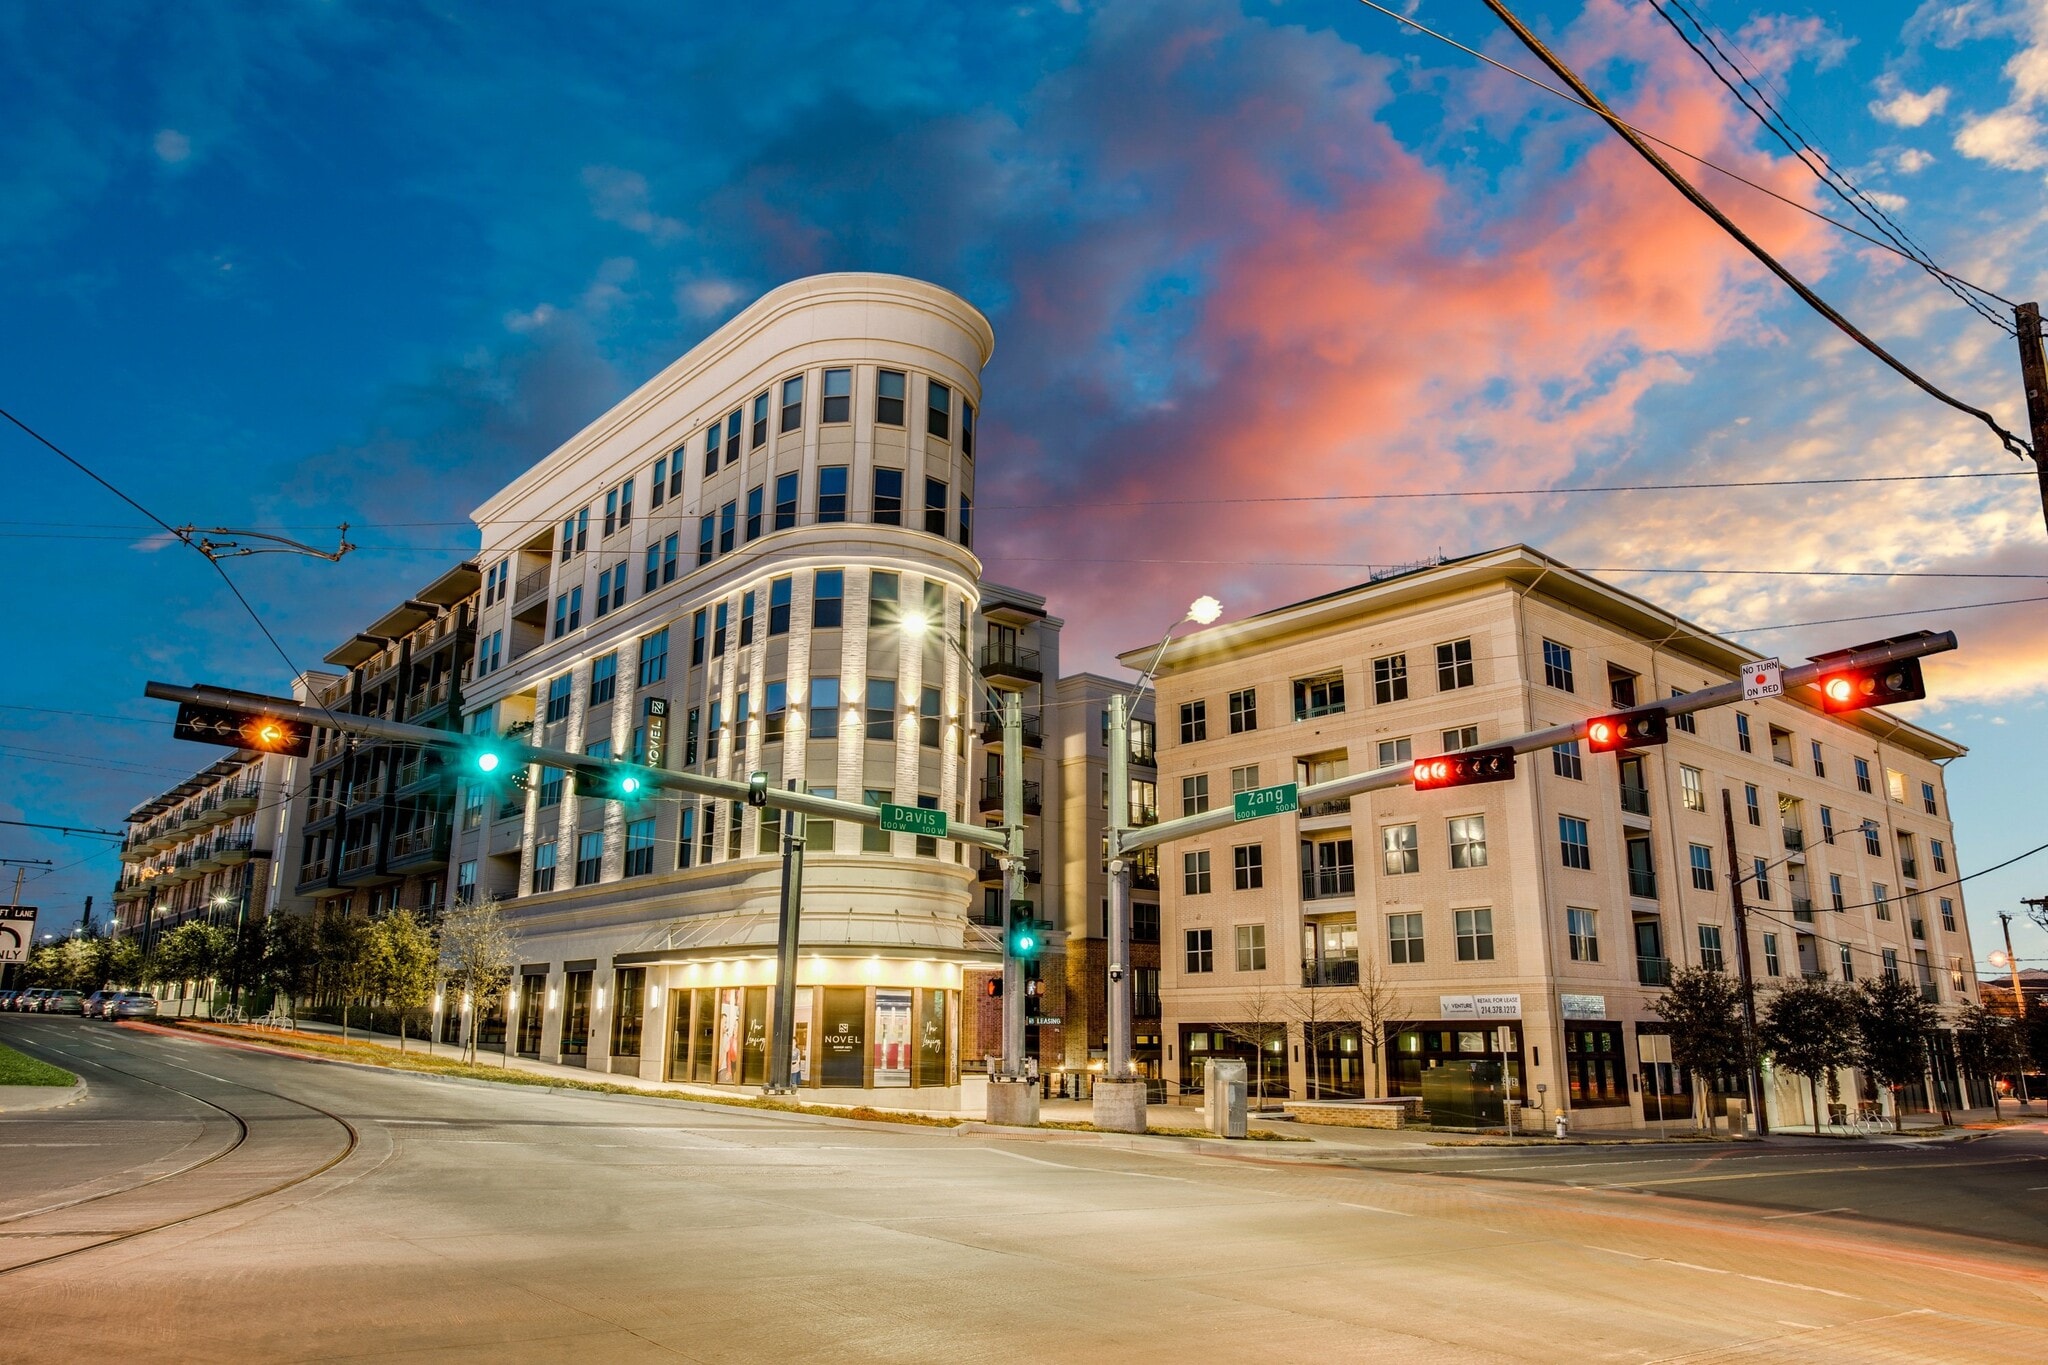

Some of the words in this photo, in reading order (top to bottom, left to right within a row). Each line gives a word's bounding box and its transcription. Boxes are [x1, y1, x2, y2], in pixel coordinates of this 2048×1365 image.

[1743, 666, 1754, 674] NO
[1756, 662, 1778, 672] TURN
[1747, 688, 1758, 696] ON
[1762, 684, 1778, 694] RED
[1248, 789, 1283, 806] Zang
[1276, 804, 1290, 812] 500
[895, 808, 935, 825] Davis
[1237, 810, 1250, 819] 600
[883, 821, 898, 830] 100
[922, 826, 936, 834] 100
[15, 910, 35, 918] LANE
